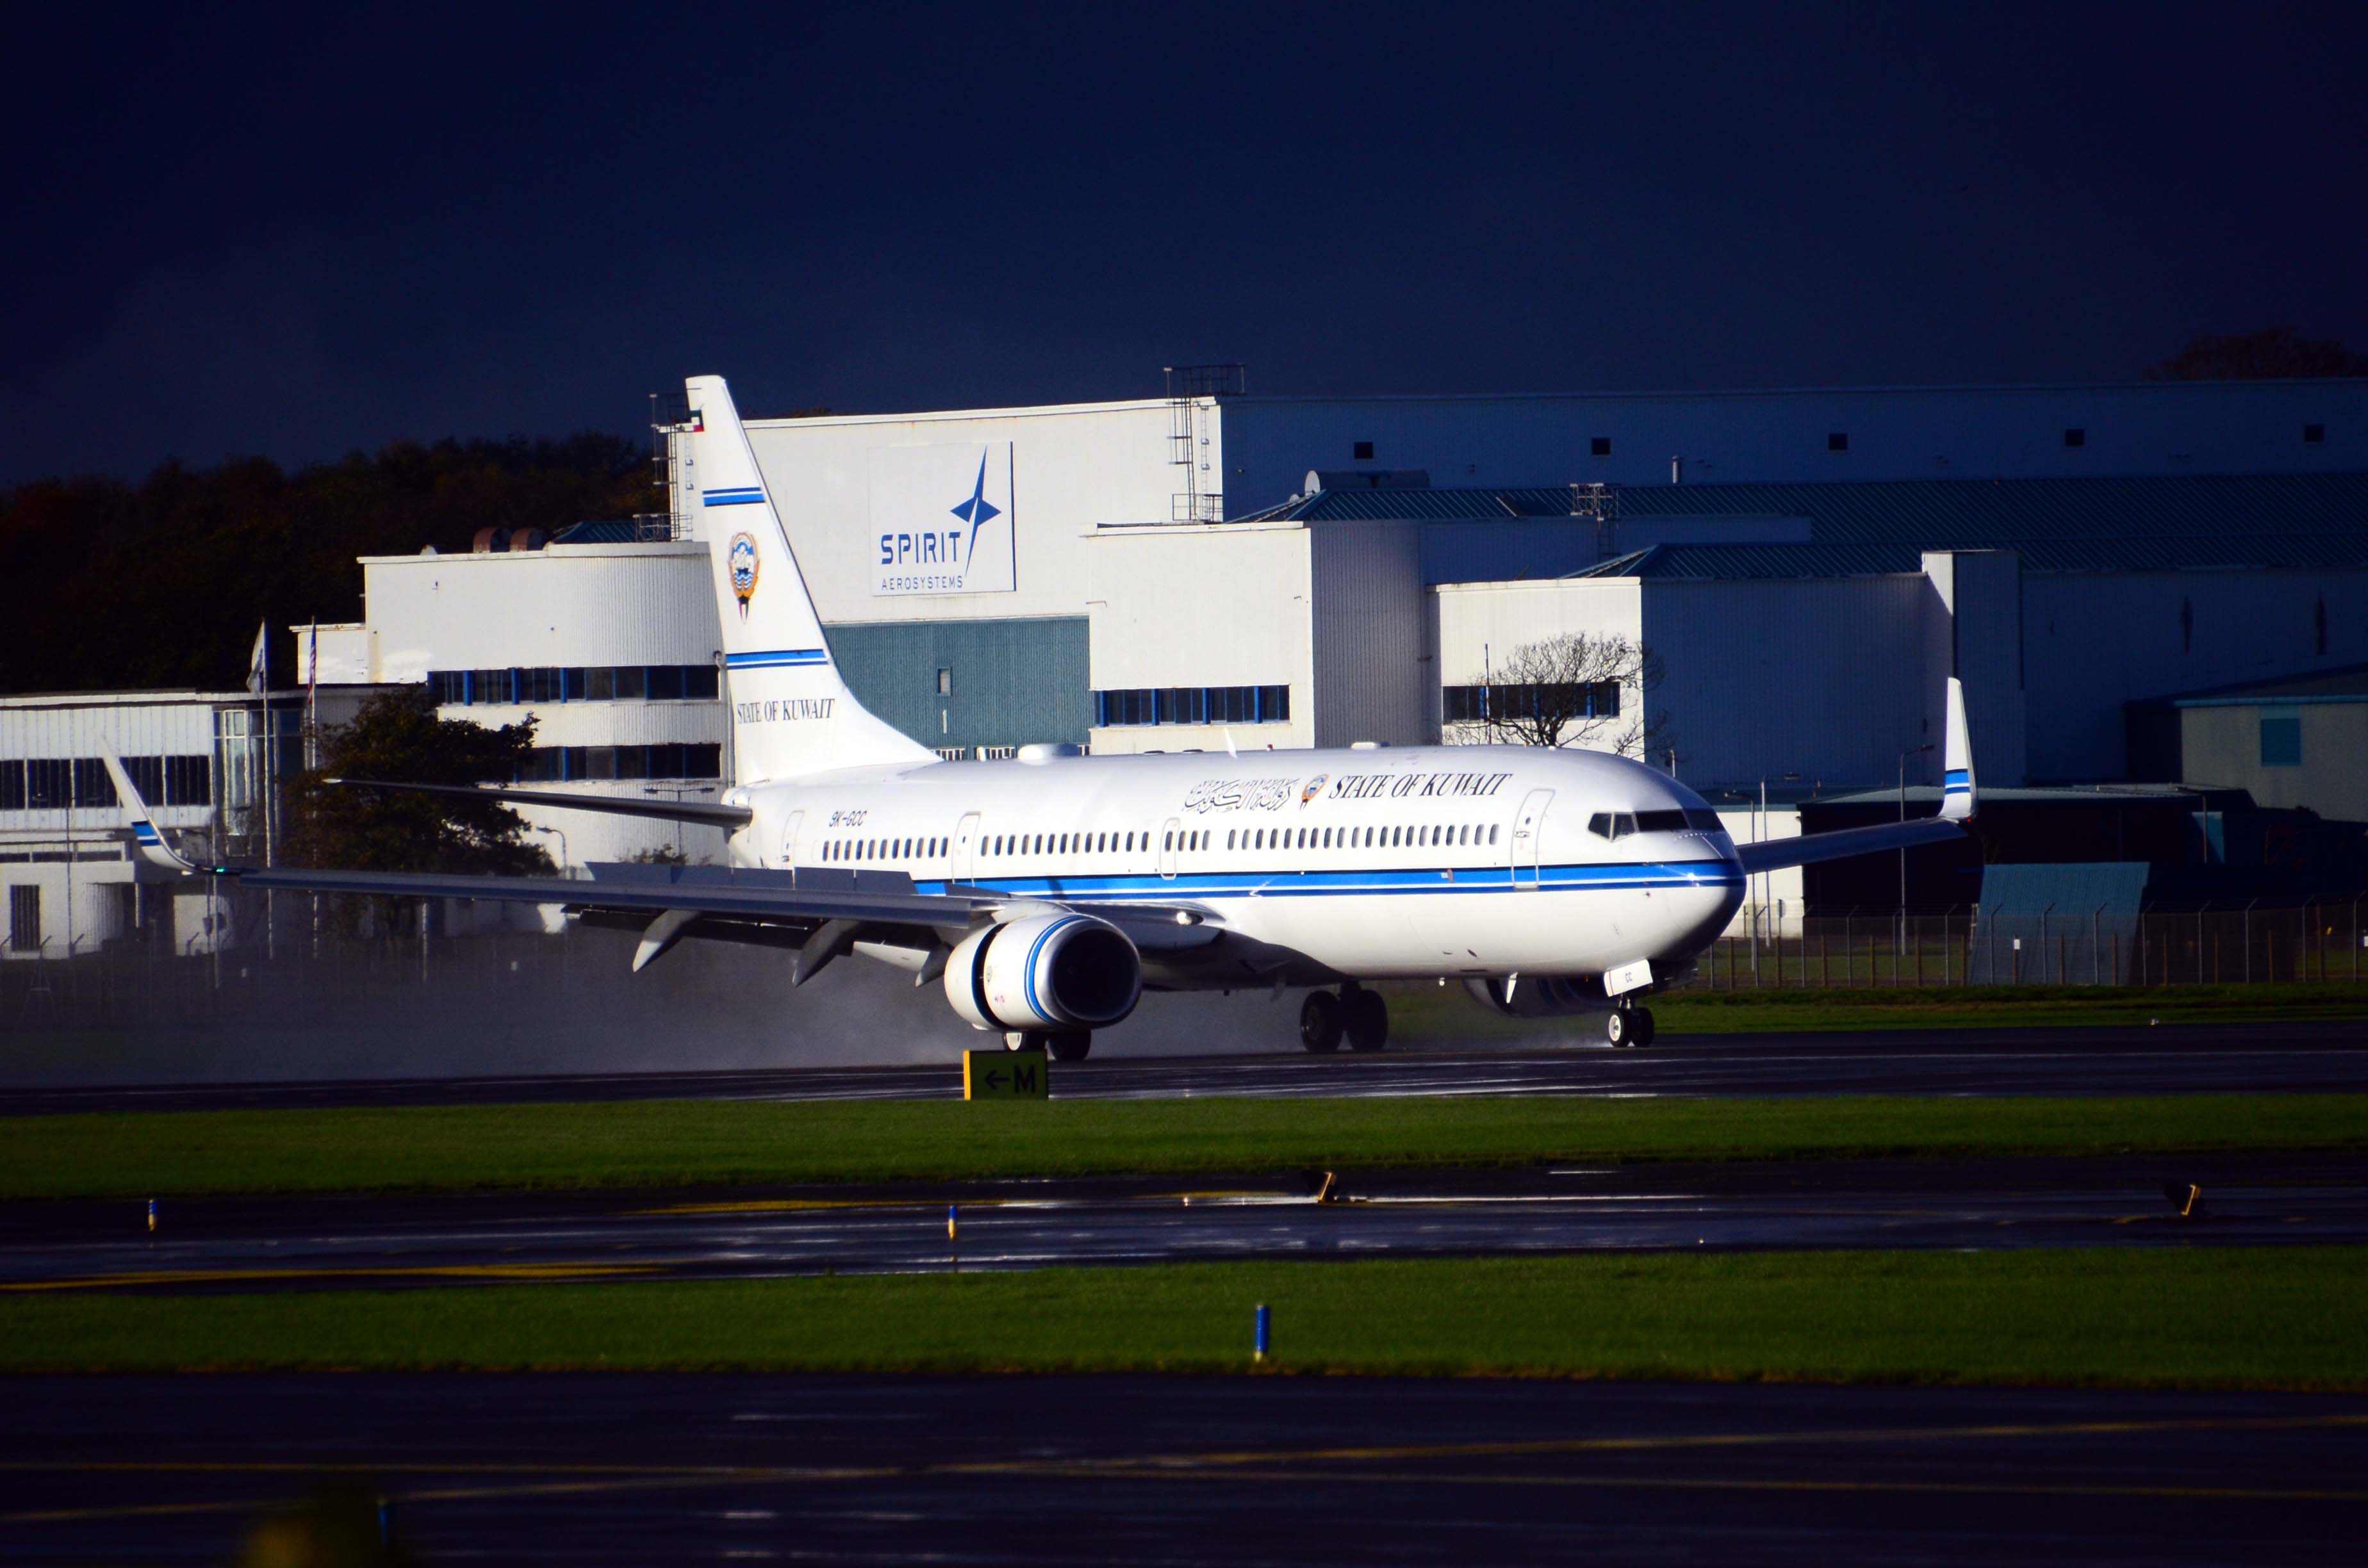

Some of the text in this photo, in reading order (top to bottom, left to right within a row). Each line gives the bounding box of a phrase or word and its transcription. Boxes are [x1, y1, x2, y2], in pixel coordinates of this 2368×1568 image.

[881, 531, 961, 565] SPIRIT
[882, 575, 963, 591] AEROSYSTEMS
[737, 698, 835, 724] STATE OF KUWAIT
[1328, 773, 1514, 799] STATE OF KUWAIT
[828, 810, 867, 828] 9K-GCC
[1014, 1065, 1036, 1093] M
